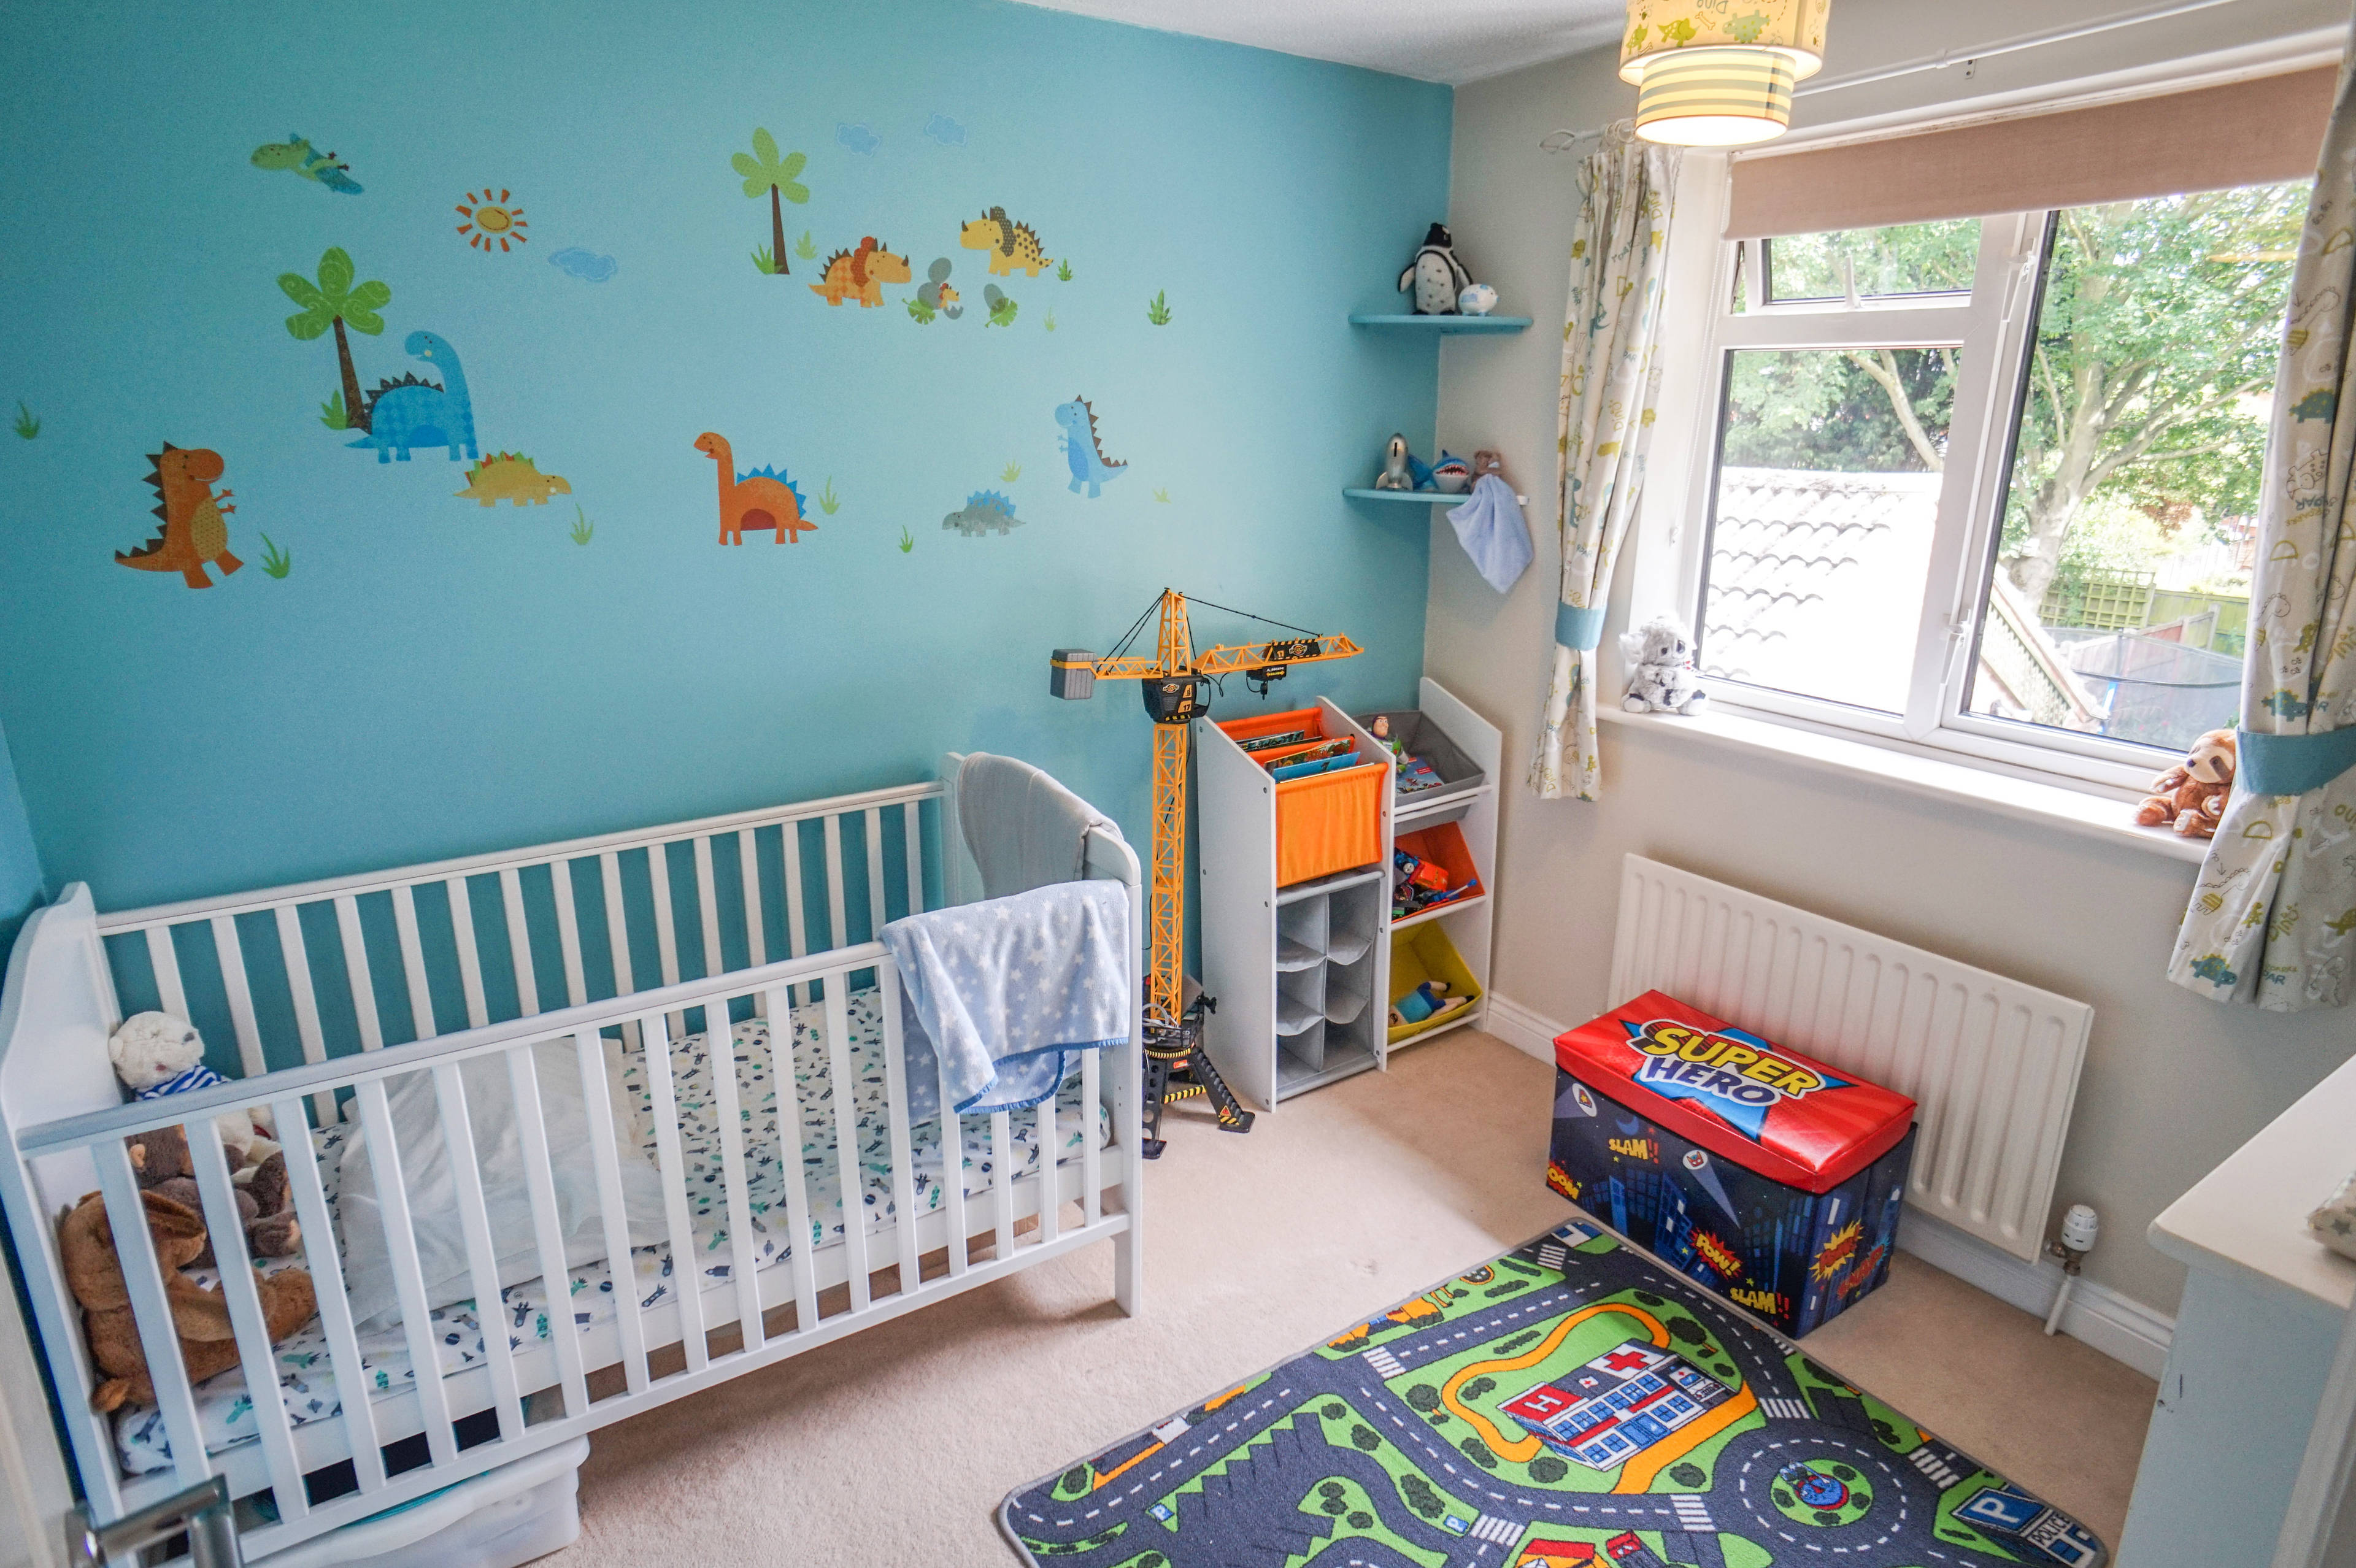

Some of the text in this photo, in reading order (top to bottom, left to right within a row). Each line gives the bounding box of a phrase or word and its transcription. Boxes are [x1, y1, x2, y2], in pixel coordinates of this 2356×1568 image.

[1609, 399, 1625, 431] Dino
[1642, 1027, 1819, 1096] SUPER
[1645, 1056, 1775, 1104] HERO
[1548, 1167, 1580, 1201] OOM
[1696, 1233, 1741, 1277] POW!
[1524, 1394, 1563, 1413] H
[1446, 1517, 1464, 1532] P
[1970, 1497, 2020, 1524] P
[2031, 1513, 2070, 1545] POLICE
